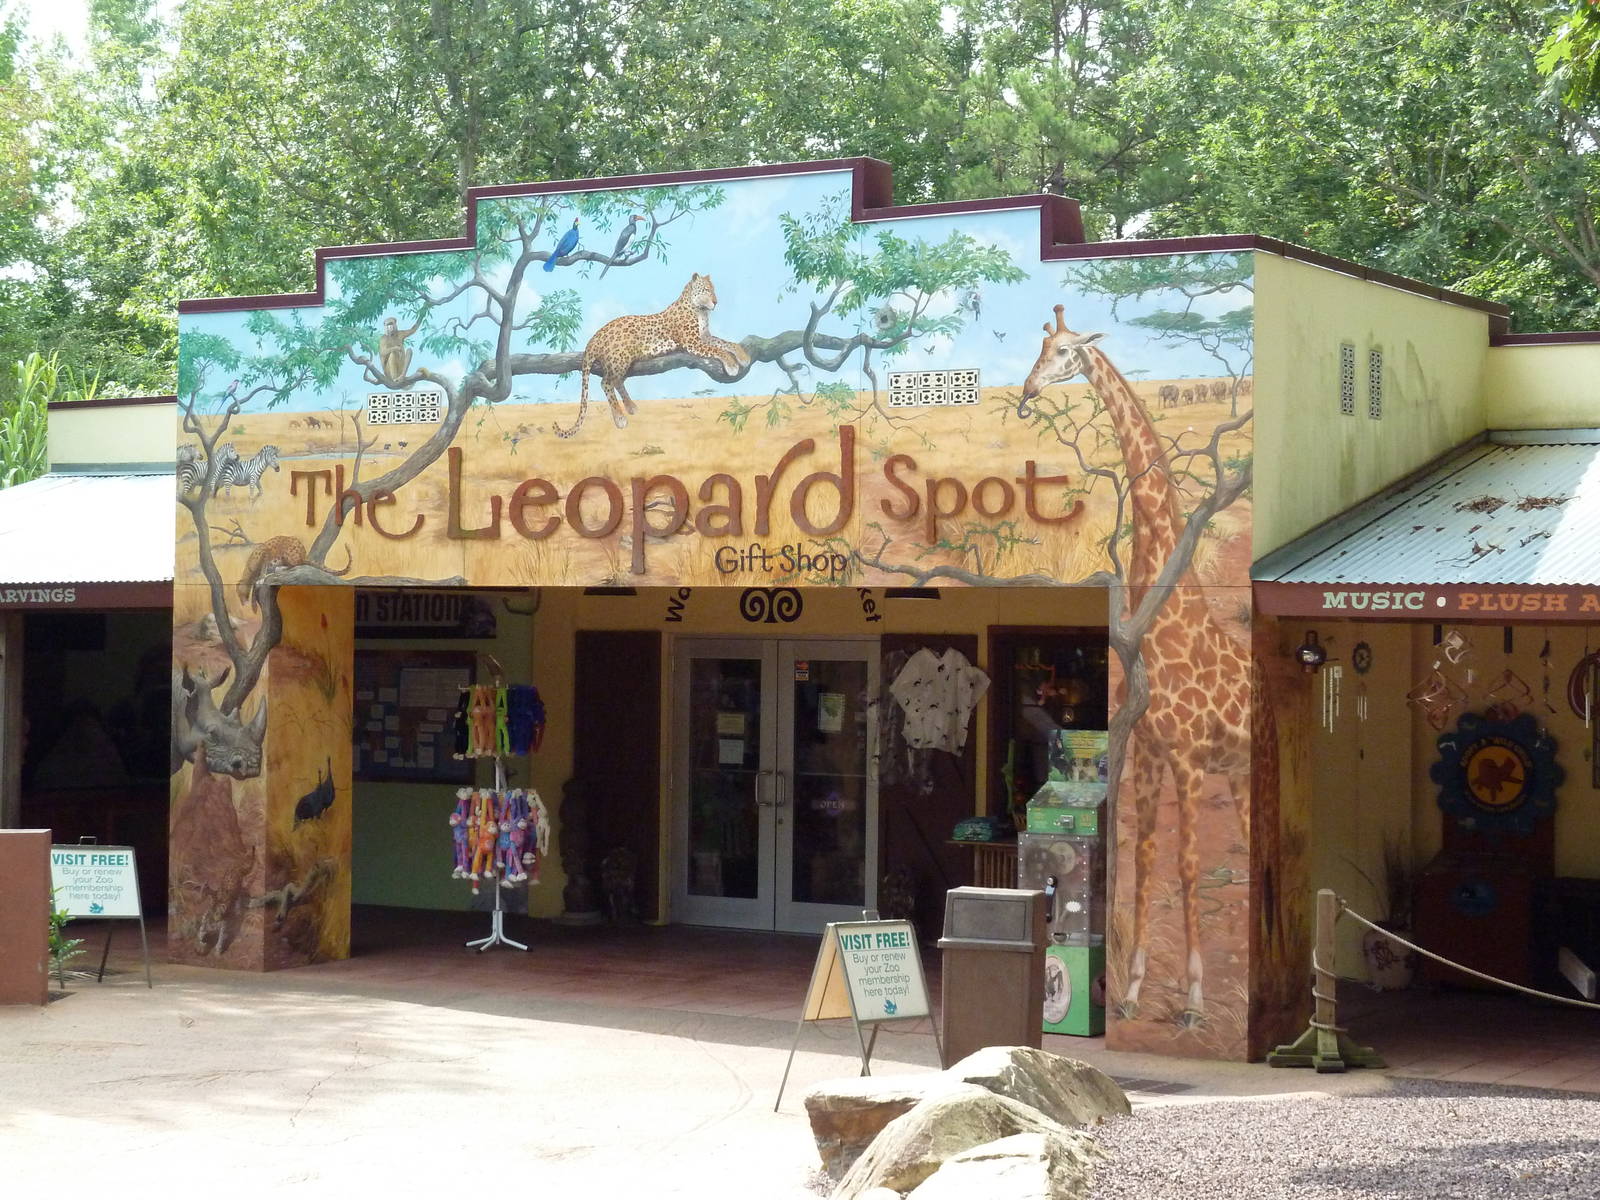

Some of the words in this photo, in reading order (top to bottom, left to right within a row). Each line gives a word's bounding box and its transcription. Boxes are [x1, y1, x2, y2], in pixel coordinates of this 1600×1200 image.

[290, 464, 424, 540] The
[447, 425, 855, 575] Leopard
[881, 453, 1084, 544] Spot
[715, 544, 774, 574] Gift
[777, 543, 848, 578] Shop
[1322, 591, 1425, 611] MUSIC
[1458, 592, 1567, 612] PLUSH
[52, 853, 87, 865] VISIT
[91, 854, 129, 866] FREE!
[62, 867, 80, 877] Buy
[95, 875, 114, 884] Zoo
[64, 884, 124, 894] membership
[841, 934, 872, 950] VISIT
[877, 932, 910, 948] FREE!
[853, 954, 868, 965] Buy
[881, 953, 906, 961] renew
[864, 966, 882, 976] your
[884, 963, 900, 973] Zoo
[858, 974, 911, 985] membership
[864, 987, 883, 997] here
[885, 985, 910, 996] today!
